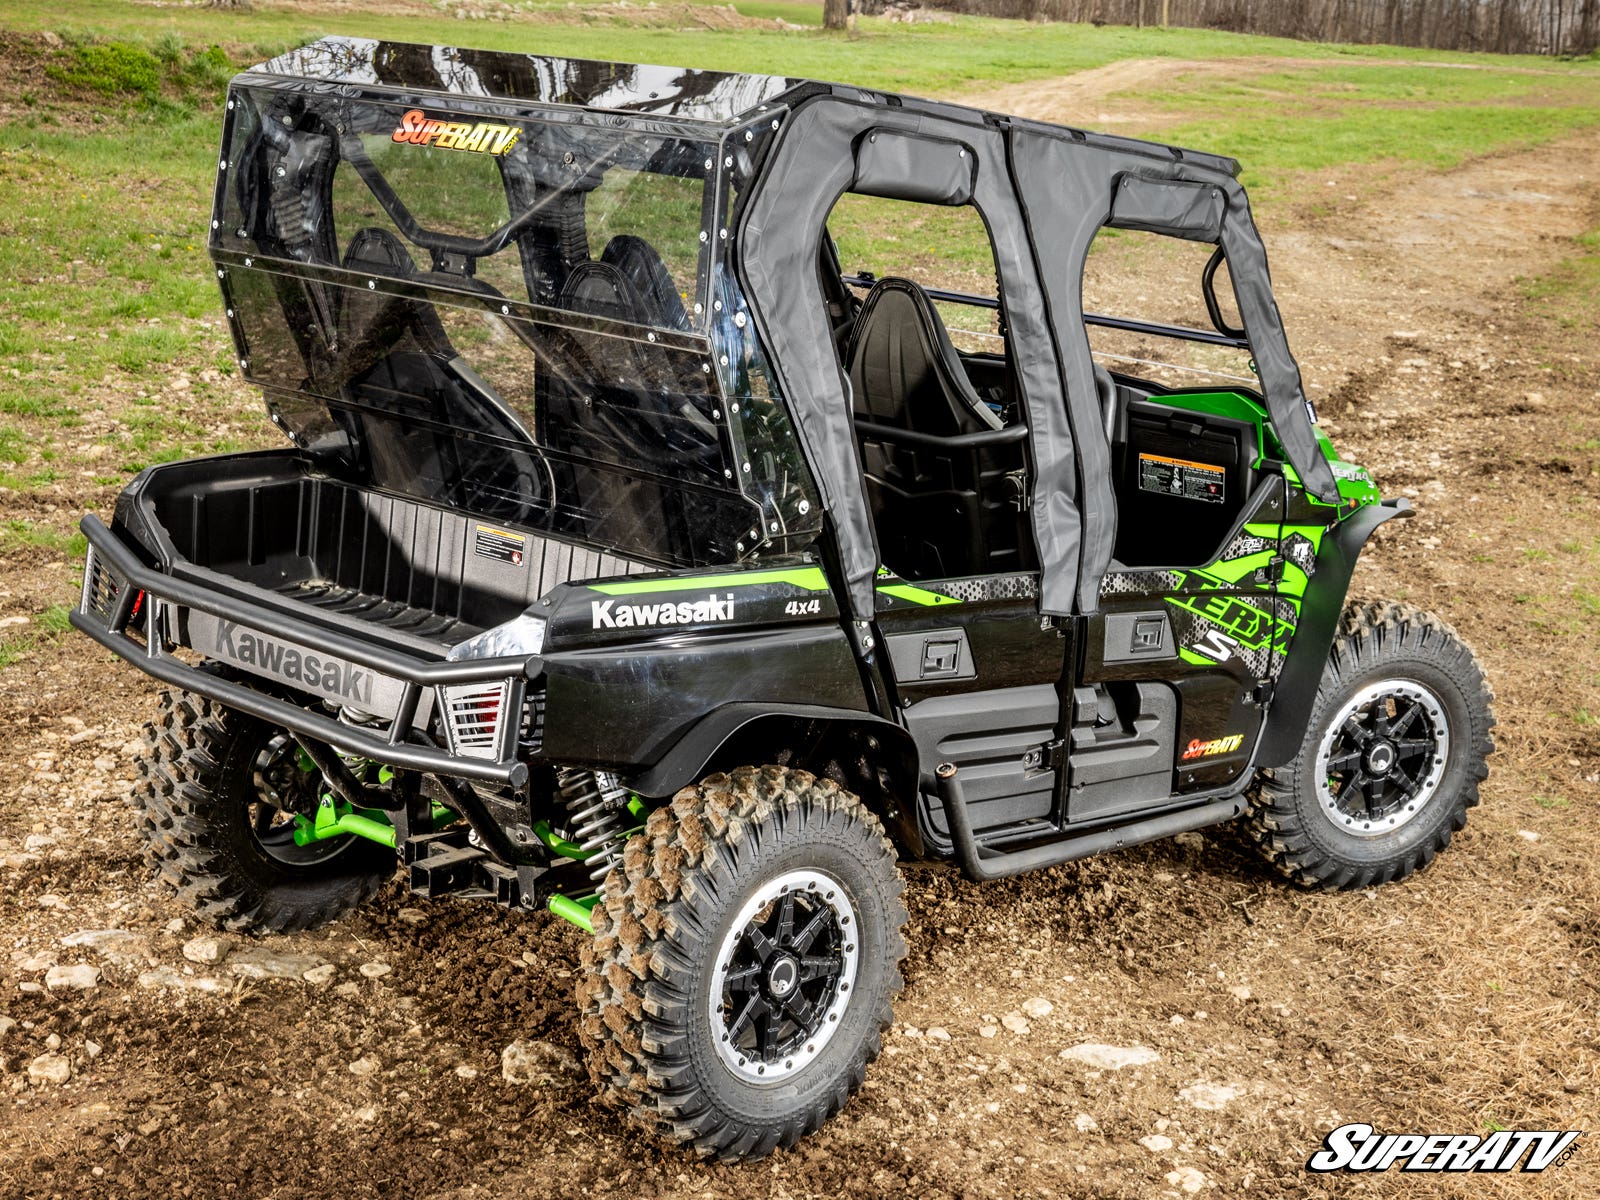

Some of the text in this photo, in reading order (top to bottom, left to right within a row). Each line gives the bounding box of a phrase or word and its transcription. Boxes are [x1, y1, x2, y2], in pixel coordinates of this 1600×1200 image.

[392, 109, 520, 156] SUPERATV
[591, 593, 821, 630] Kawasaki 4x4
[215, 617, 373, 706] Kawasaki
[1182, 735, 1243, 760] SUPERATV
